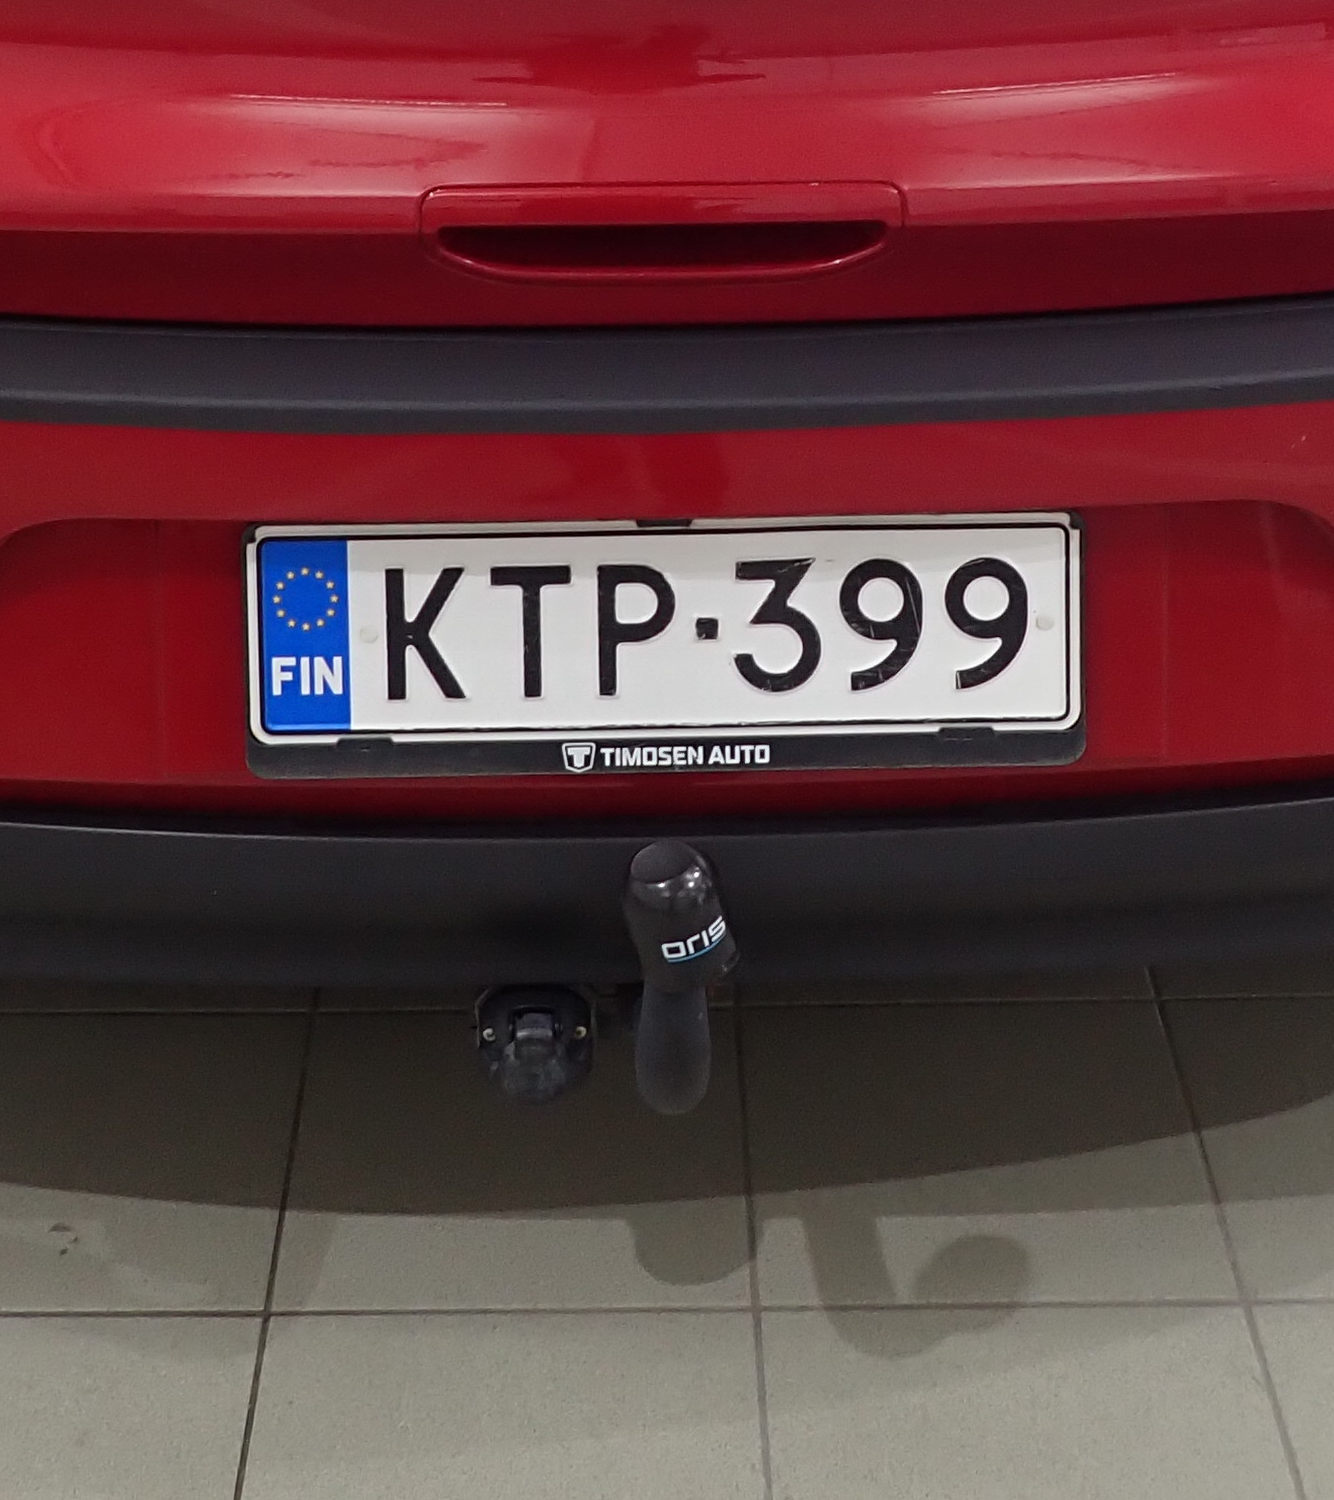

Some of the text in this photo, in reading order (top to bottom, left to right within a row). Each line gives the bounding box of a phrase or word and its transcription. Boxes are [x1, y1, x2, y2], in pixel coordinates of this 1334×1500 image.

[385, 557, 1028, 700] KTP-399
[272, 657, 344, 696] FIN
[600, 747, 704, 766] TIMOSEN
[708, 745, 770, 764] AUTO
